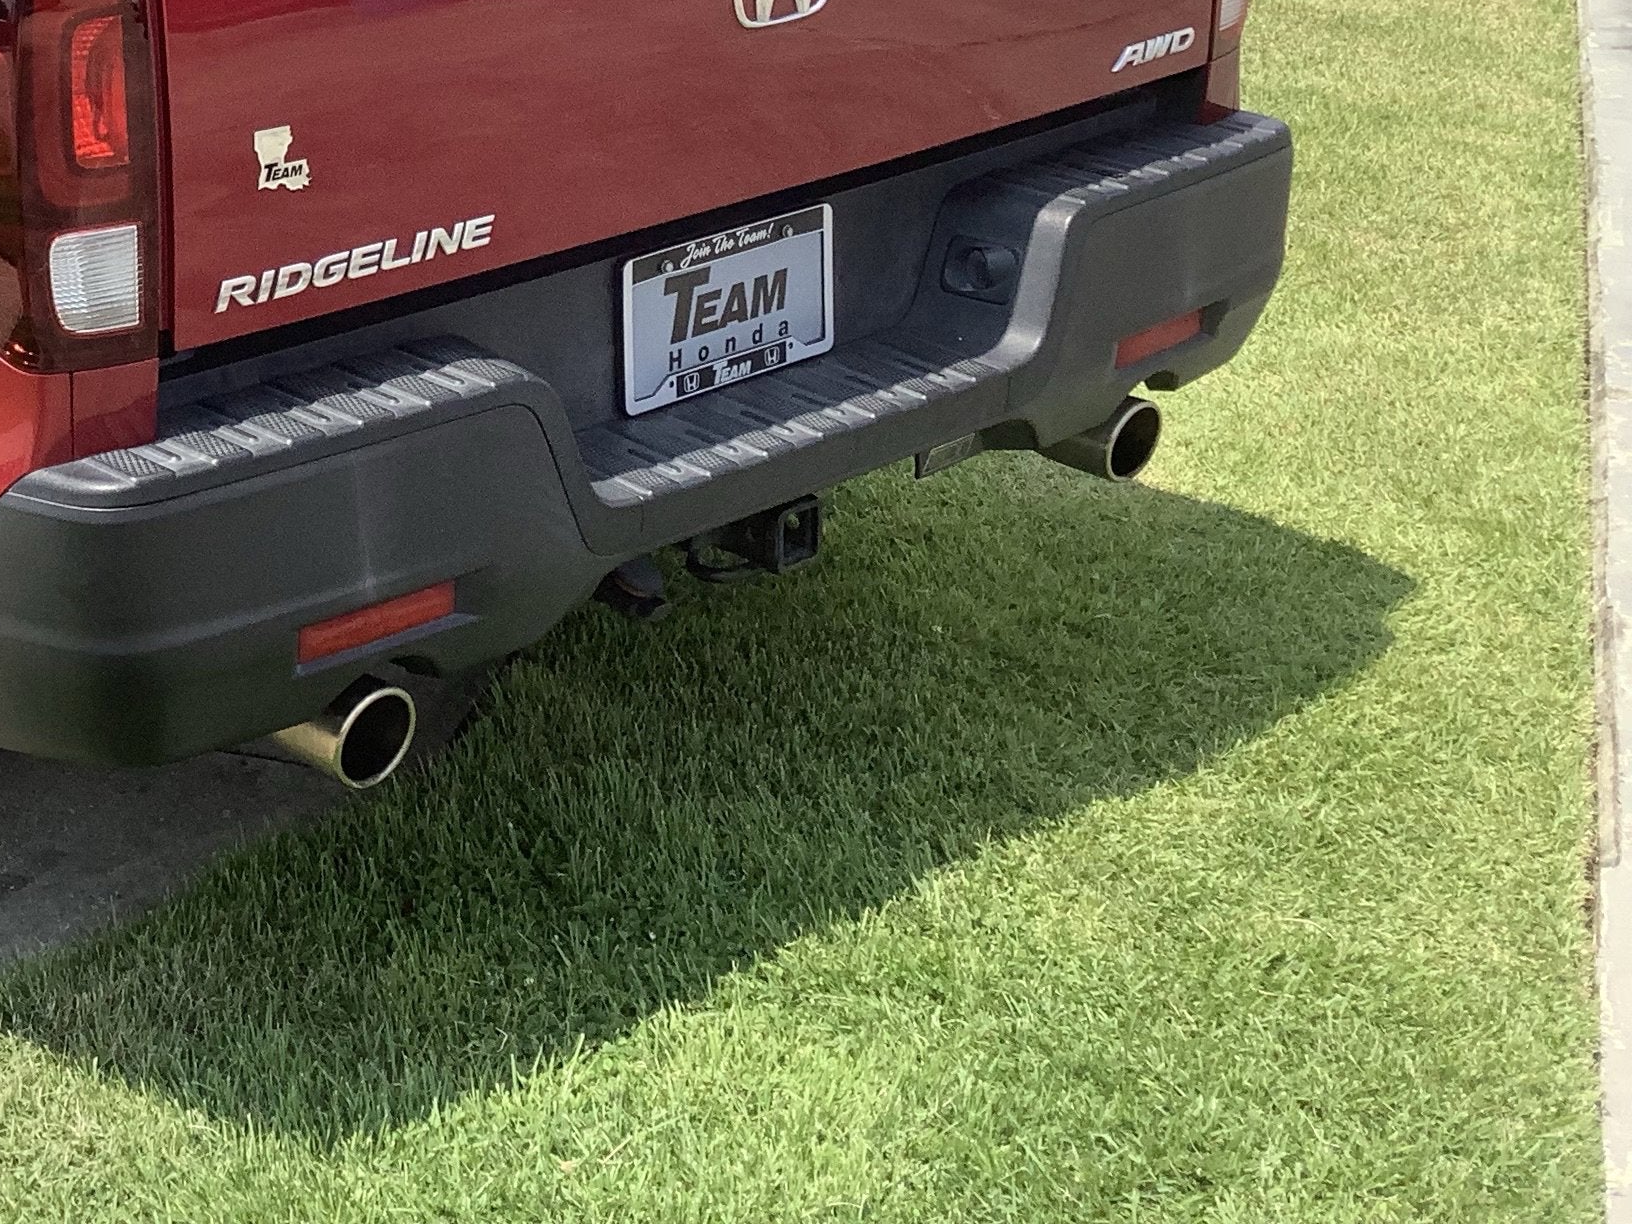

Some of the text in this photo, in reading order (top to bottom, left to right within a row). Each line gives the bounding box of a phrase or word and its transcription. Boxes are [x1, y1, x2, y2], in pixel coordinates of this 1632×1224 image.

[1111, 27, 1195, 73] AWD
[264, 162, 304, 183] TEAM
[214, 213, 496, 314] RIDGELINE
[680, 222, 774, 268] Join The Team!
[664, 266, 788, 345] TEAM
[712, 360, 752, 386] TEAM
